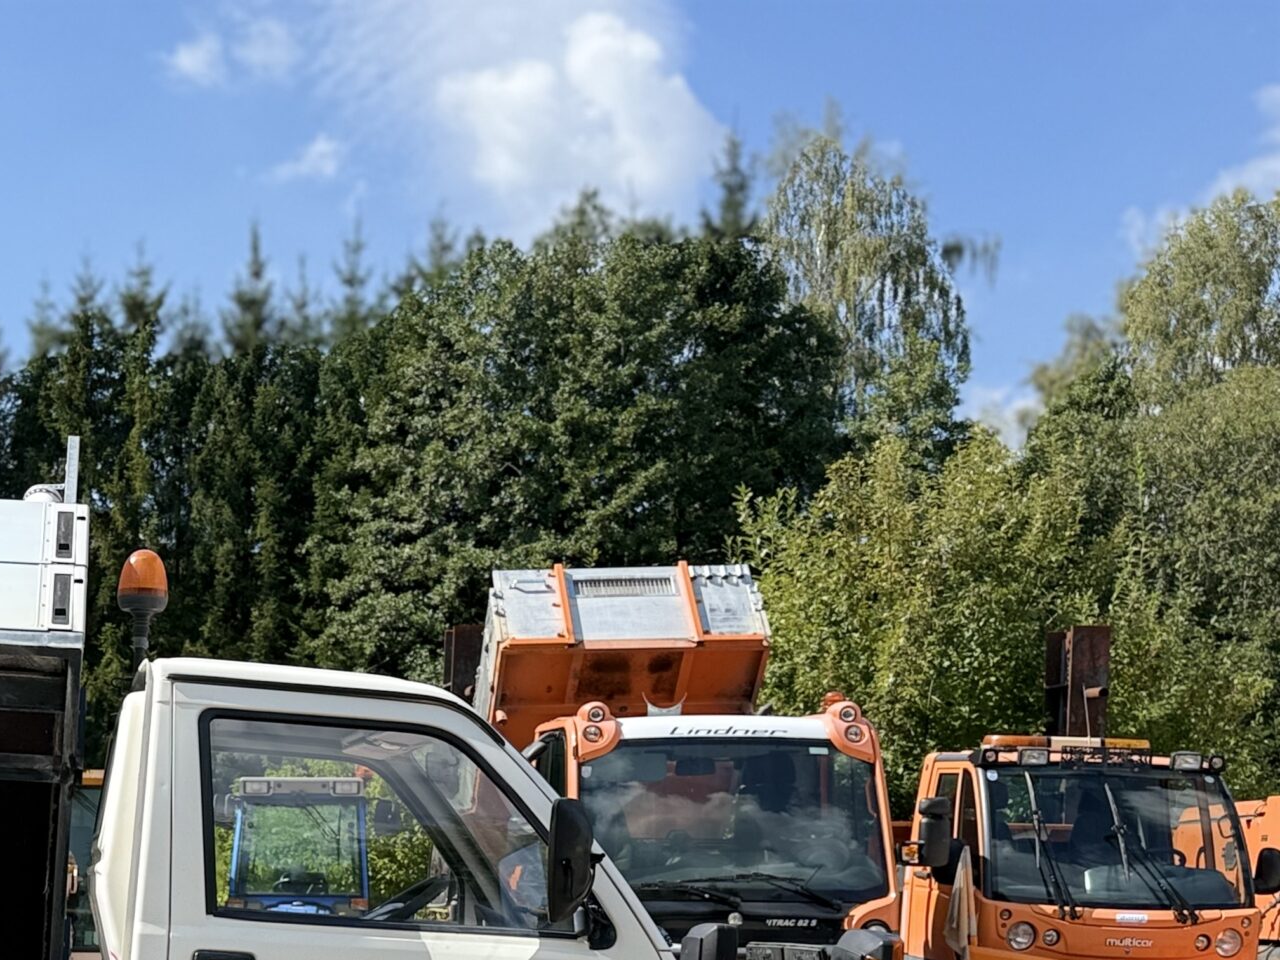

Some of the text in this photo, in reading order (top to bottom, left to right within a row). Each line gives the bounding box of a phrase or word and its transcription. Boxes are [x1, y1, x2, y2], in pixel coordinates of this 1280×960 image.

[670, 726, 788, 735] Lindner
[797, 918, 809, 927] 82
[1106, 938, 1153, 947] multicar
